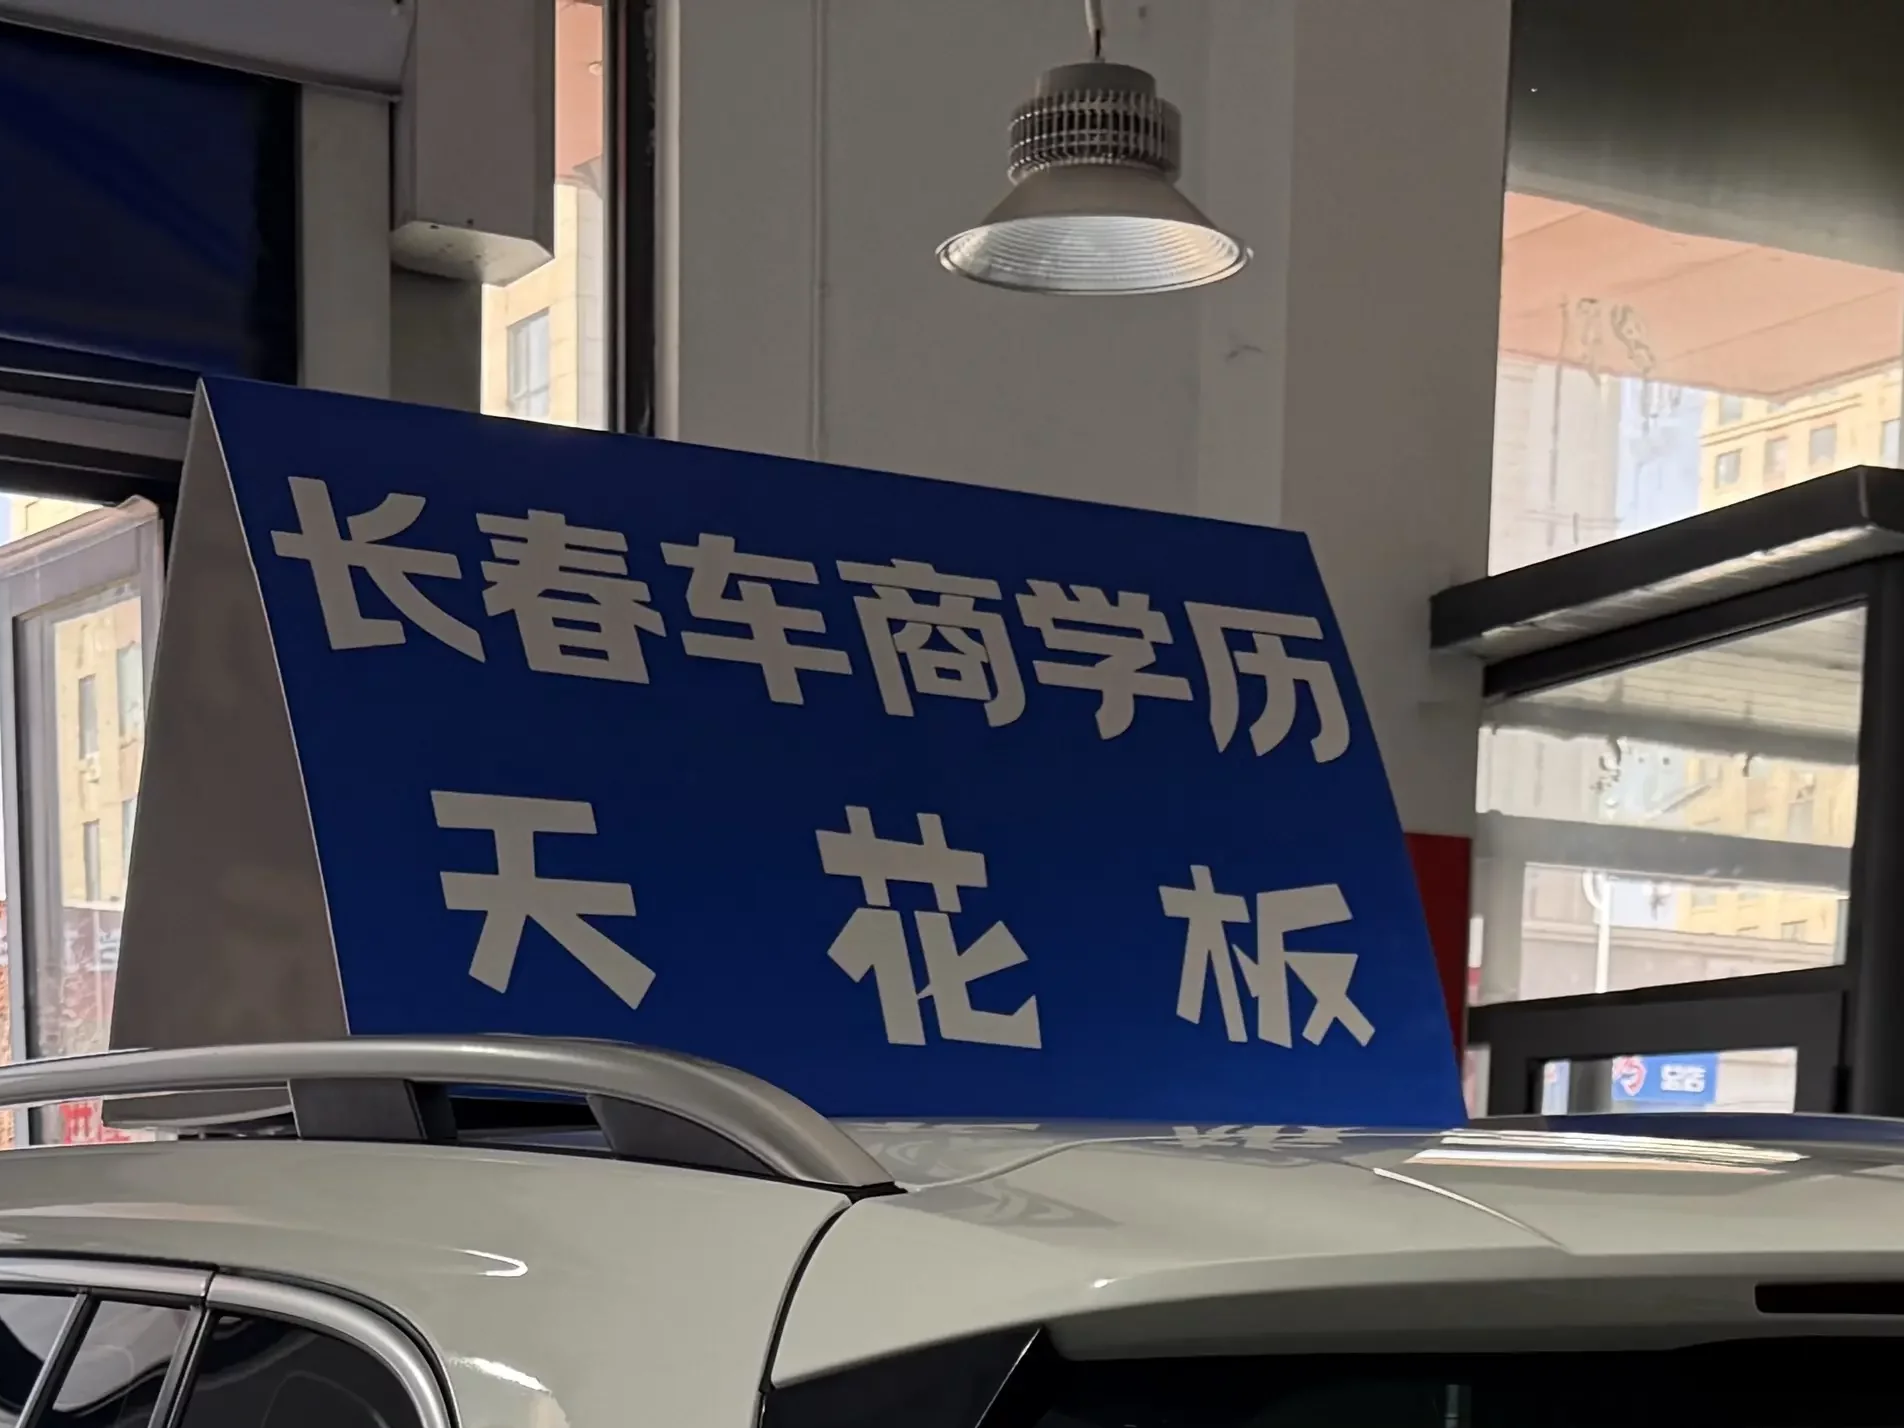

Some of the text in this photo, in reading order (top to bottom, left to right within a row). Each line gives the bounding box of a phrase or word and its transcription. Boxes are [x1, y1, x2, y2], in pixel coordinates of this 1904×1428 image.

[271, 476, 1351, 763] 长春车商学历
[429, 789, 1376, 1050] 天花板
